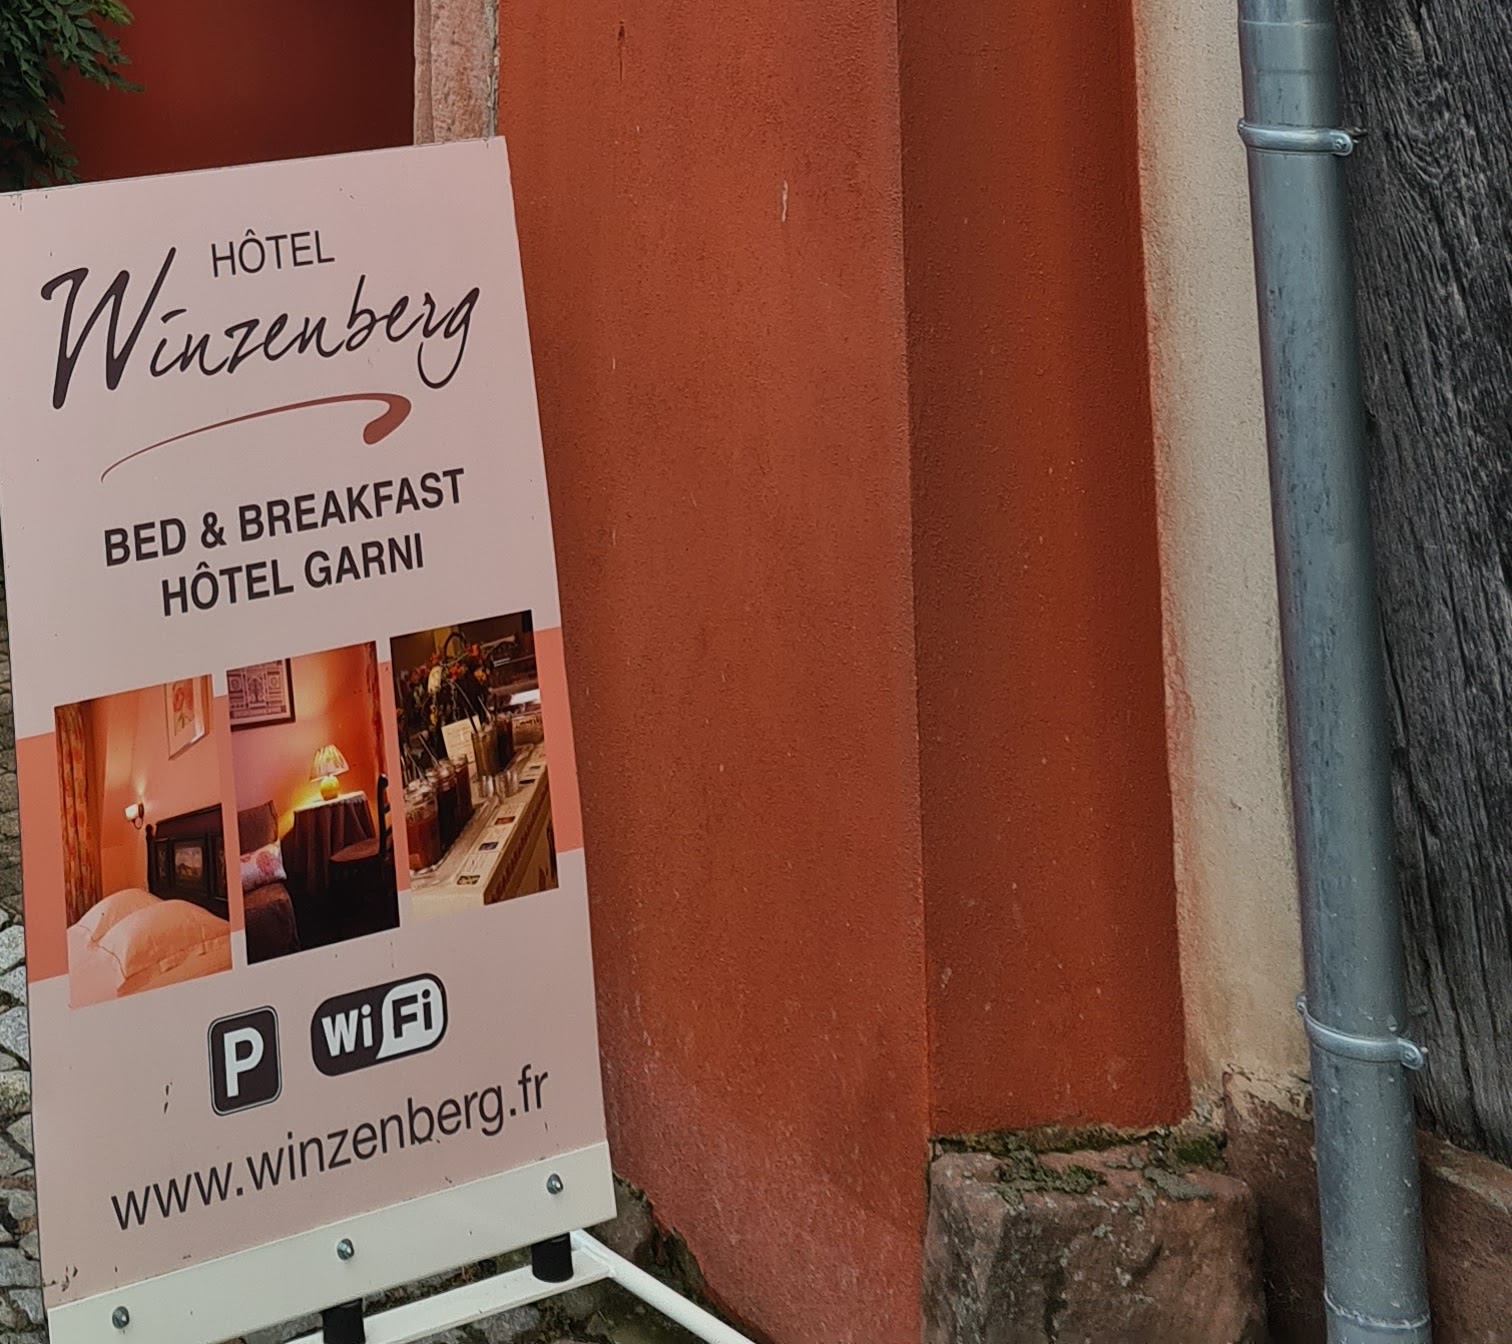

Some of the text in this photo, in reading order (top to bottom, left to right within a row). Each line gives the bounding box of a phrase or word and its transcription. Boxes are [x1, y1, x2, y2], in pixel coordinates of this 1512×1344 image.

[211, 229, 336, 278] HÔTEL
[40, 246, 480, 410] Winzenberg
[104, 467, 465, 567] BED & BREAKFAST
[161, 532, 424, 617] HÔTEL GARNI
[223, 1026, 264, 1098] P
[110, 1064, 549, 1231] www.winzenberg.fr
